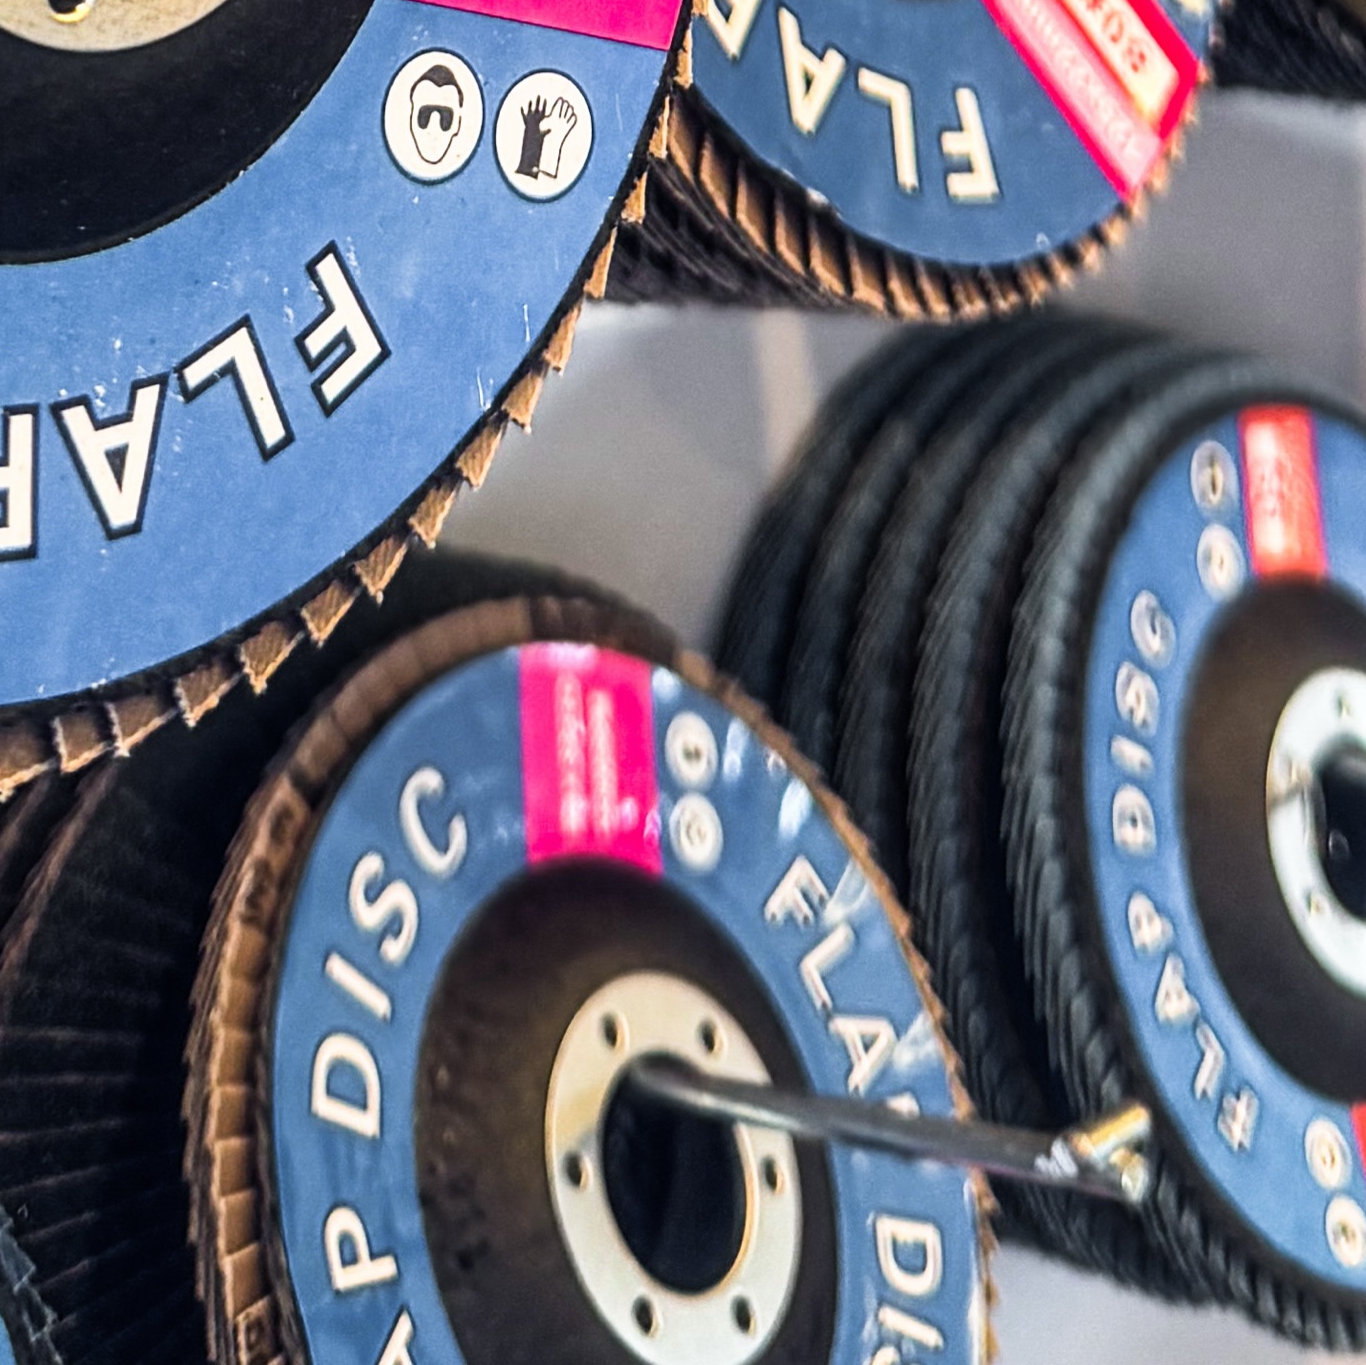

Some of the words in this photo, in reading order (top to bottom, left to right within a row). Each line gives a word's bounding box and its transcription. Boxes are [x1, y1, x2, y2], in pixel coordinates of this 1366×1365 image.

[1109, 588, 1178, 859] DISC
[311, 766, 468, 1140] DISC
[762, 855, 921, 1119] FLA
[872, 1212, 945, 1365] DI
